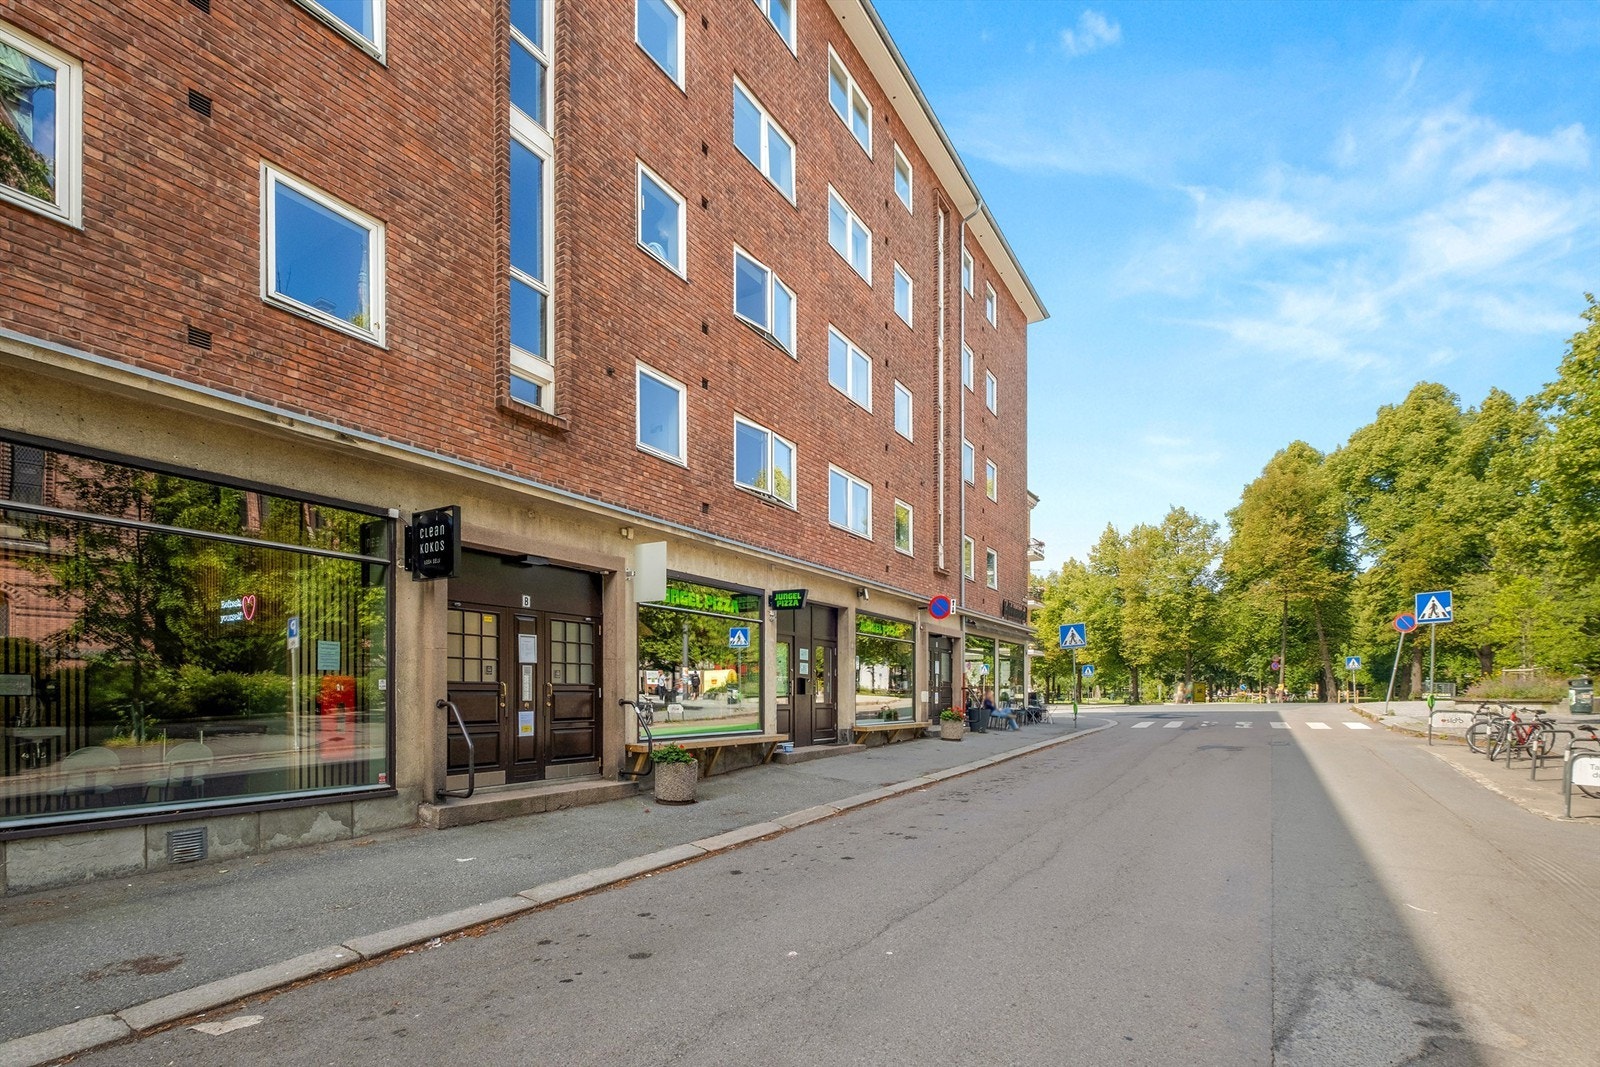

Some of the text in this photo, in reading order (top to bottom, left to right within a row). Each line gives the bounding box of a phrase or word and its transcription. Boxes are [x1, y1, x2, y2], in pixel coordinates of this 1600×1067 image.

[420, 540, 445, 554] KOKOS
[524, 596, 529, 606] B
[774, 592, 802, 601] JUNGEL
[705, 594, 739, 614] PIZZA
[776, 599, 799, 607] PIZZA
